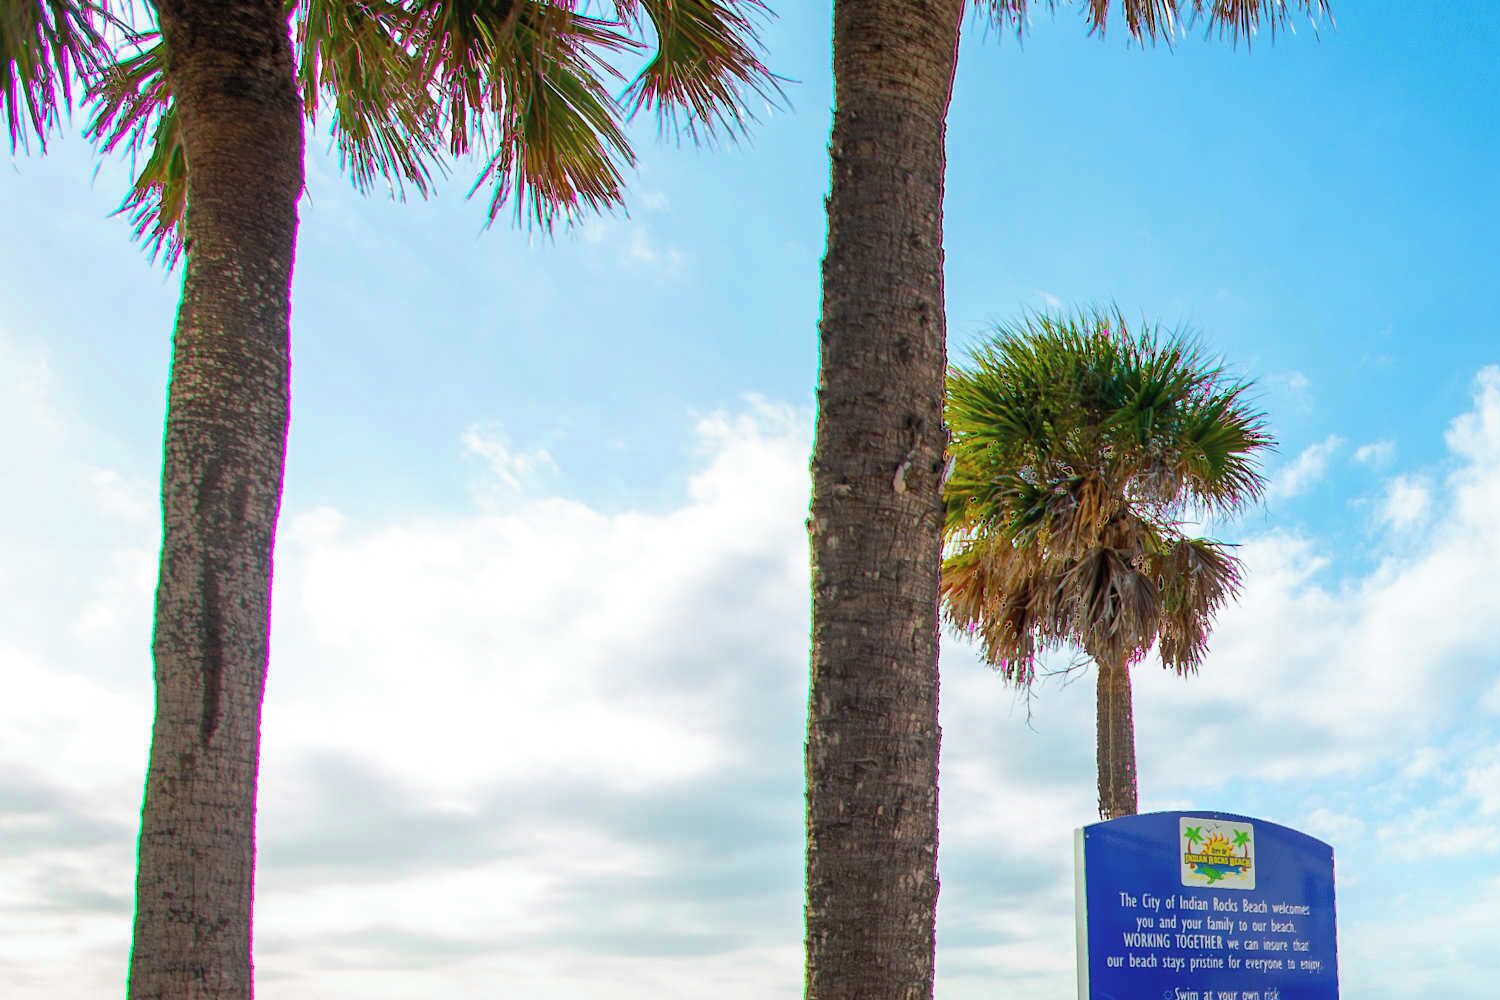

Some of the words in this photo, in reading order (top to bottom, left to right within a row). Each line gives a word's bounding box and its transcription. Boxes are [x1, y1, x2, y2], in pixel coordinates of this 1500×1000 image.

[1120, 892, 1137, 908] The
[1142, 893, 1160, 912] City
[1165, 894, 1175, 909] of
[1180, 896, 1208, 911] Indian
[1213, 897, 1238, 912] Rocks
[1243, 899, 1267, 913] Beach
[1272, 901, 1310, 915] welcomes
[1136, 917, 1154, 932] you
[1159, 915, 1176, 928] and
[1182, 919, 1202, 933] your
[1207, 916, 1234, 935] family
[1239, 920, 1248, 932] to
[1252, 922, 1267, 932] our
[1271, 920, 1297, 933] beach.
[1123, 932, 1171, 948] WORKING
[1175, 934, 1223, 949] TOGETHER
[1227, 940, 1239, 950] we
[1244, 941, 1258, 951] can
[1263, 937, 1288, 951] insure
[1293, 939, 1309, 951] that
[1107, 956, 1123, 968] our
[1129, 953, 1157, 968] beach
[1162, 956, 1185, 972] stays
[1190, 954, 1224, 973] pristine
[1228, 954, 1240, 969] for
[1245, 958, 1283, 974] everyone
[1287, 959, 1295, 970] to
[1242, 991, 1259, 1000] own
[1264, 988, 1280, 1000] risk
